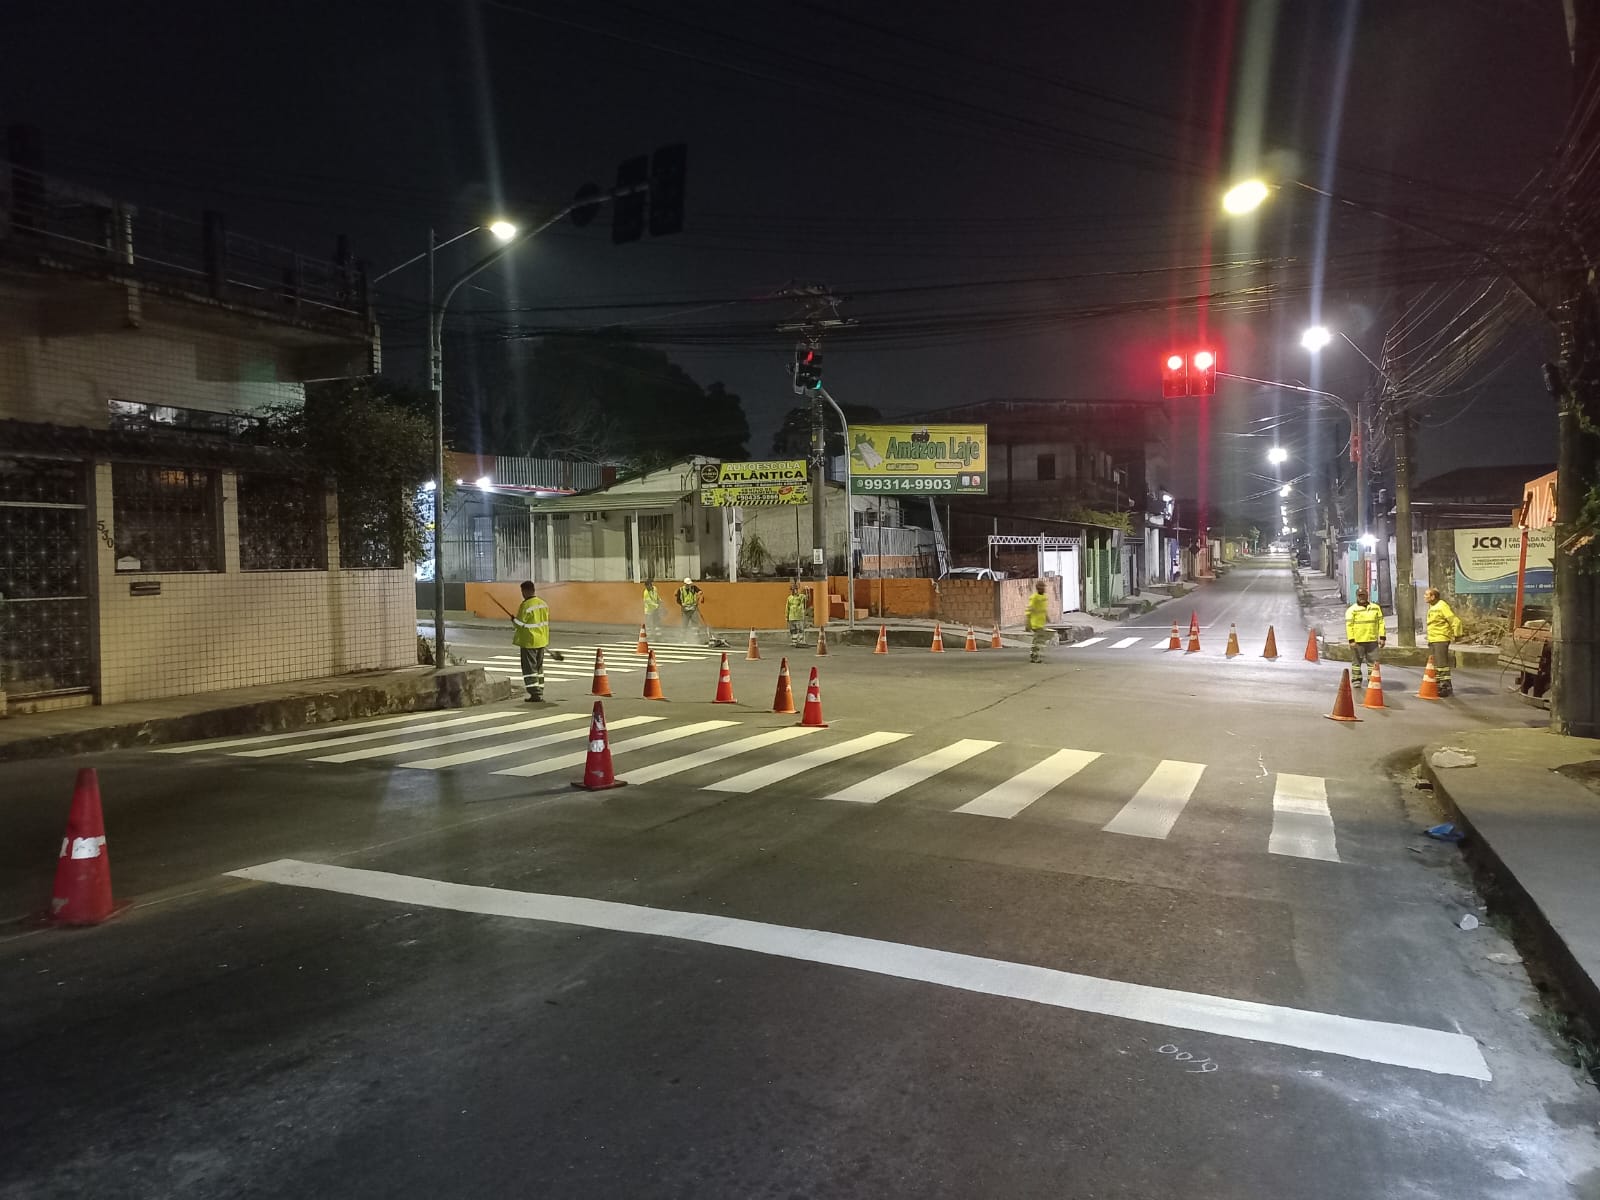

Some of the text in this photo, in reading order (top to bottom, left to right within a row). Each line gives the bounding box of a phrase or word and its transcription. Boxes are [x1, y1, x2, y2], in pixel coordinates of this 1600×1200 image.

[885, 436, 980, 467] Amazon Laje
[726, 462, 801, 471] AUTOESCOLA
[722, 470, 804, 481] ATLÂNTICA
[864, 478, 952, 491] 99314-9903
[97, 520, 114, 549] 530
[1472, 536, 1503, 550] JCQ
